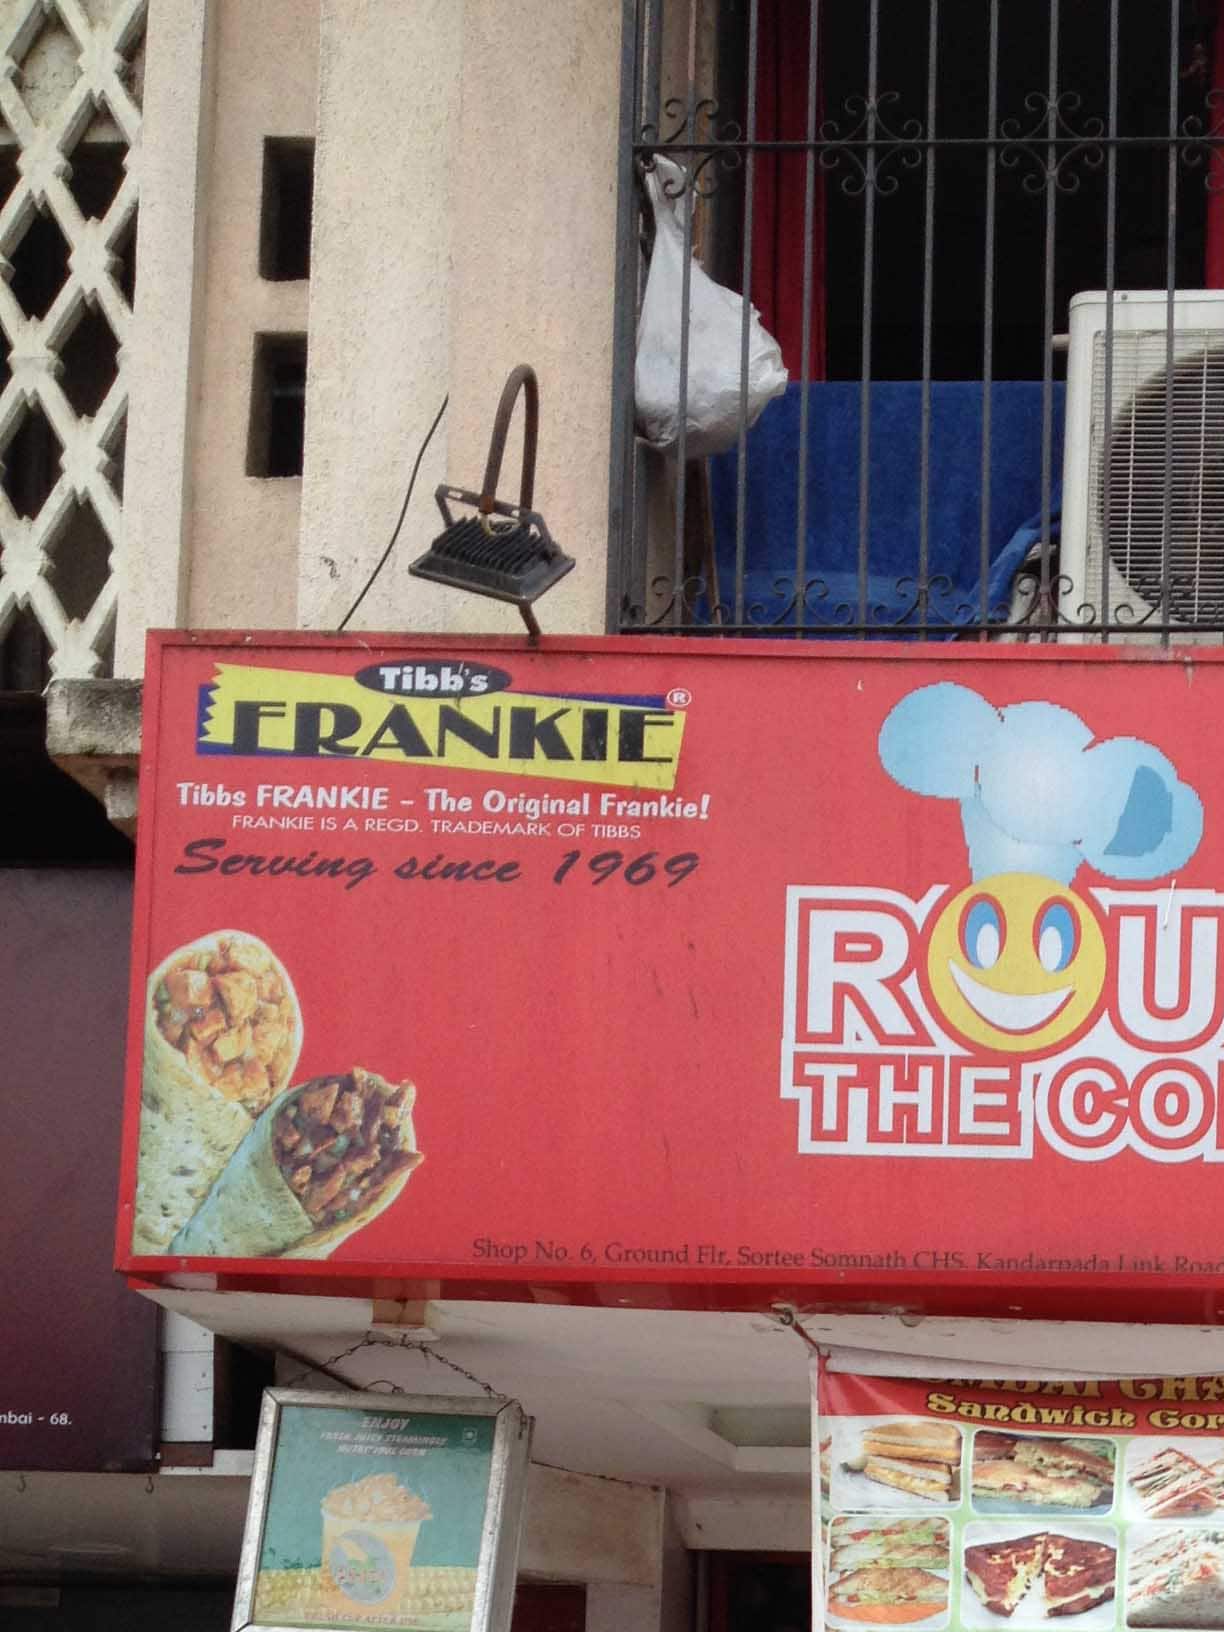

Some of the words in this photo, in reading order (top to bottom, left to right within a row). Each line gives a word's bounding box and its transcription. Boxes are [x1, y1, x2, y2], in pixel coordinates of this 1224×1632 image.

[379, 664, 489, 693] Tibb's
[232, 699, 676, 764] FRANKIE
[176, 781, 247, 808] Tibbs
[255, 784, 389, 811] FRANKIE
[423, 787, 473, 813] The
[482, 789, 590, 820] Original
[599, 792, 712, 820] Frankie!
[231, 814, 315, 831] FRANKIE
[319, 816, 337, 831] IS
[342, 817, 359, 832] A
[364, 818, 423, 834] REGD.
[431, 819, 552, 837] TRADEMARK
[557, 823, 586, 838] OF
[591, 823, 641, 840] TIBBS
[174, 837, 377, 890] Serving
[394, 852, 521, 881] since
[552, 849, 701, 889] 1969
[786, 1052, 1030, 1158] THE
[472, 1238, 528, 1263] Shop
[604, 1241, 690, 1265] Ground
[736, 1245, 803, 1267] Sortee
[810, 1247, 907, 1269] Somnath
[49, 1411, 73, 1426] 68.
[927, 1391, 1136, 1428] Sandwich
